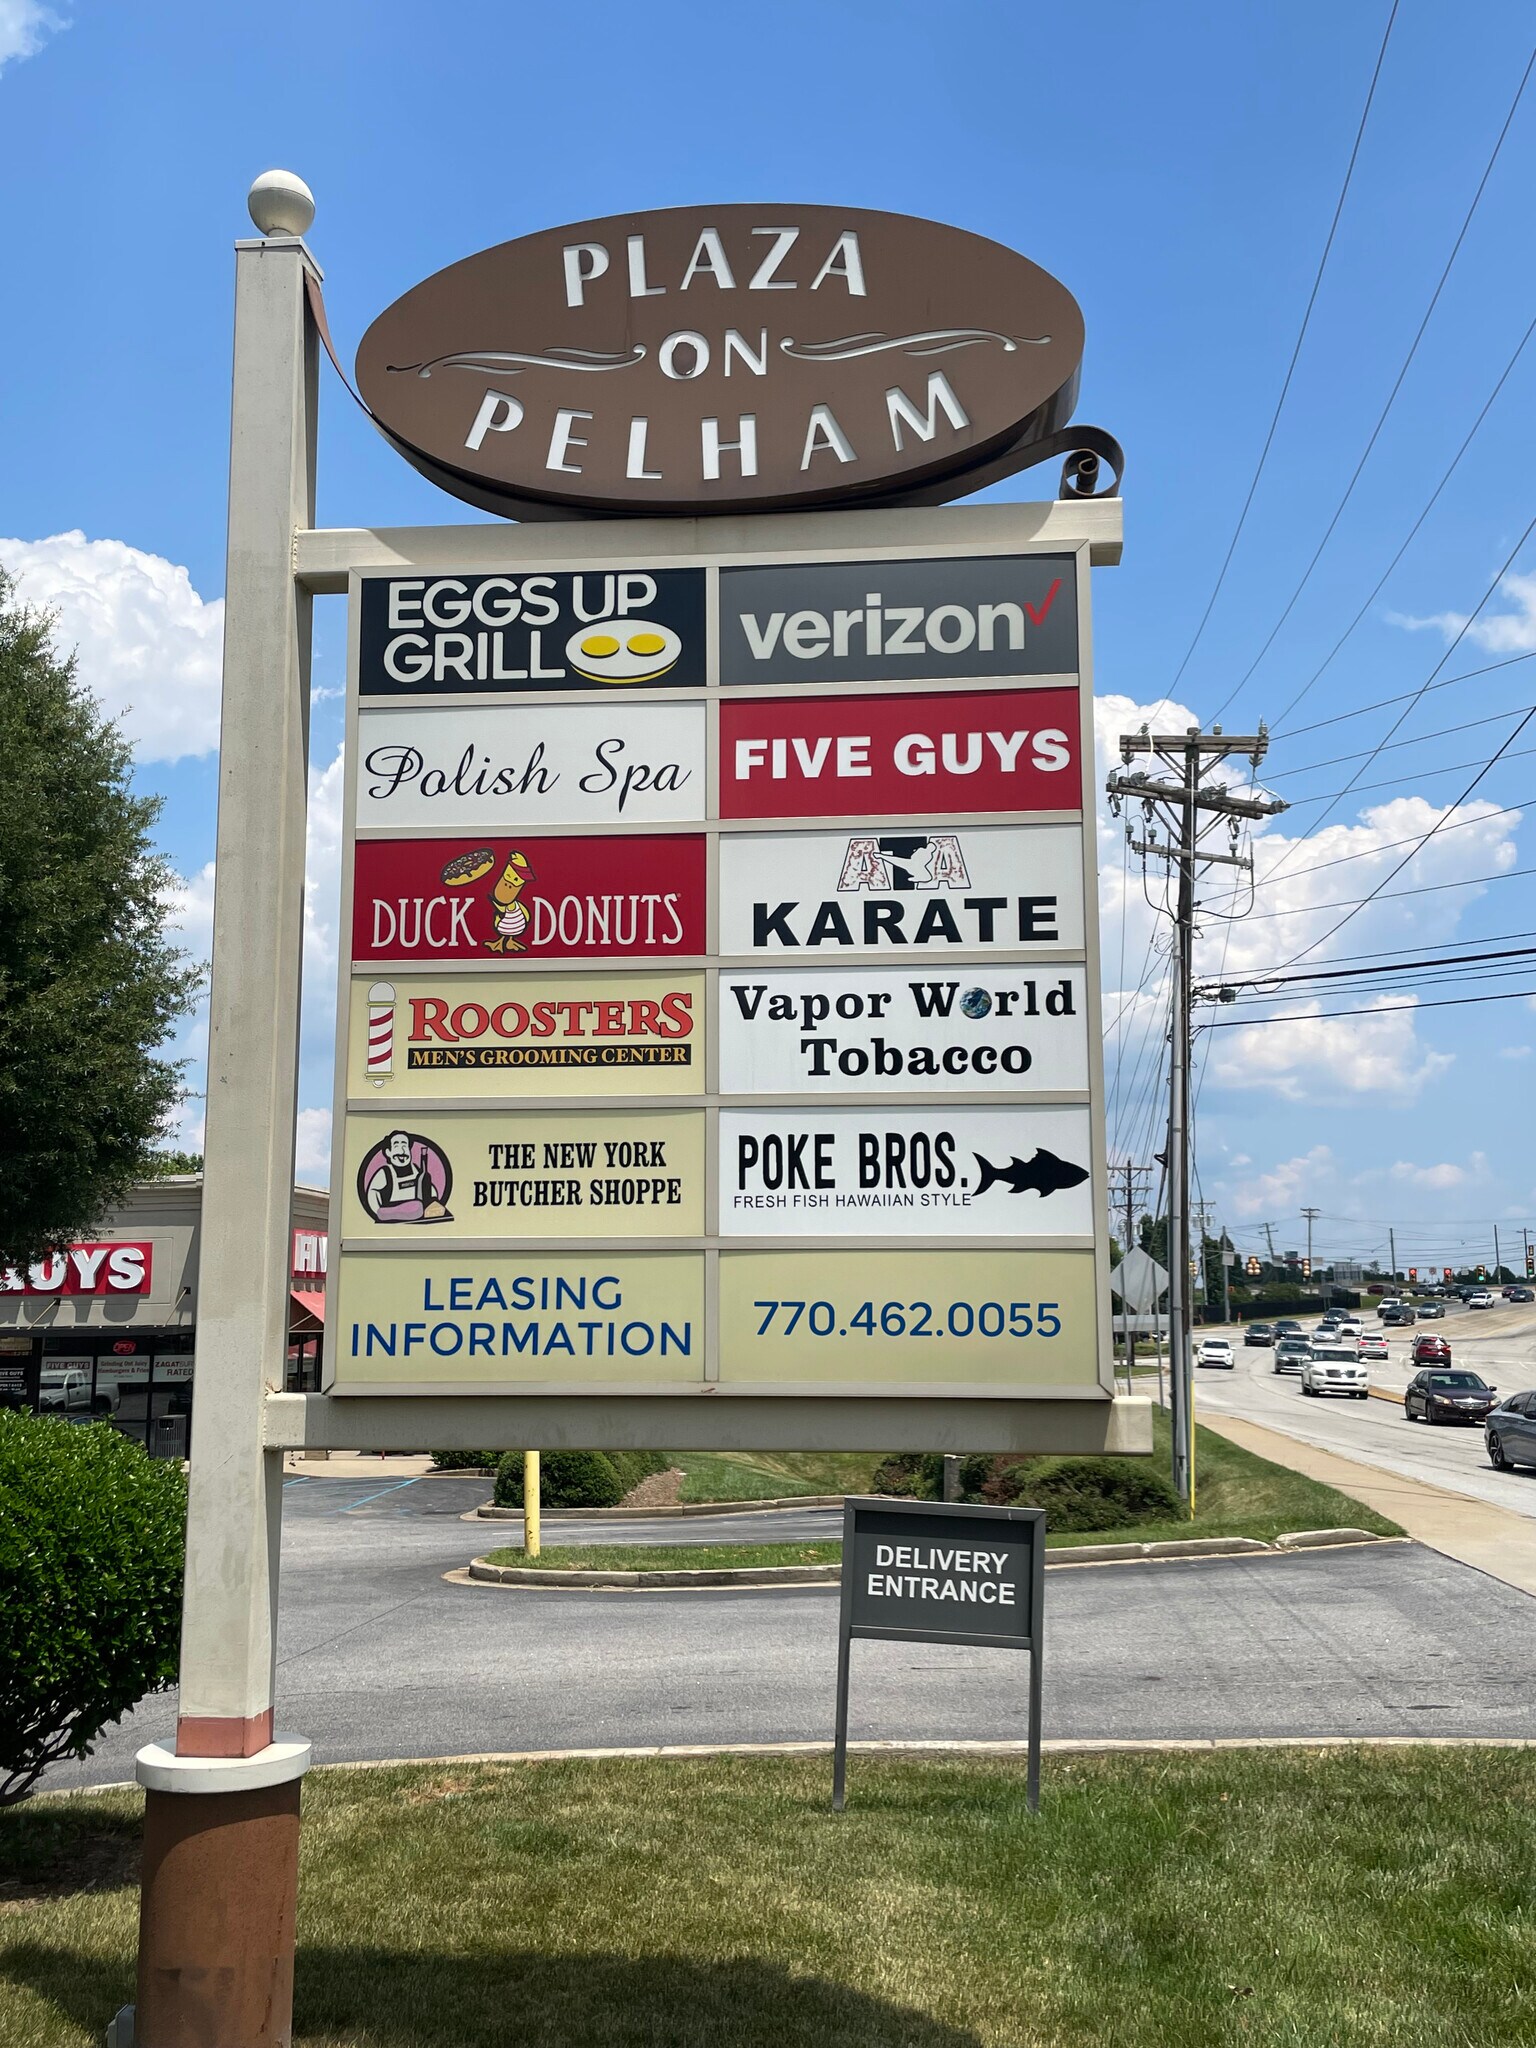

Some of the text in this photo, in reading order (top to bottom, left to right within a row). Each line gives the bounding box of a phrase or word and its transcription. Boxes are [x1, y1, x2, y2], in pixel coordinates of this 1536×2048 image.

[562, 226, 867, 307] PLAZA
[659, 328, 768, 380] ON
[464, 369, 970, 480] PELHAM
[388, 573, 658, 629] EGGS UP
[739, 593, 1025, 660] verizon
[383, 630, 566, 683] GRILL
[365, 738, 692, 813] Polish Spa
[735, 728, 1071, 780] FIVE GUYS
[837, 836, 971, 892] ATA
[371, 893, 684, 948] DUCK DONUTS
[753, 896, 1059, 947] KARATE
[408, 992, 694, 1042] ROOSTERS
[730, 980, 1076, 1031] Vapor World
[412, 1047, 688, 1067] MEN'S GROOMING CENTER
[801, 1038, 1032, 1076] Tobacco
[488, 1141, 667, 1170] THE NEW YORK
[738, 1131, 968, 1190] POKE BROS.
[473, 1178, 682, 1207] BUTCHER SHOPPE
[734, 1193, 971, 1209] FRESH FISH HAWAIIAN STYLE
[294, 1233, 328, 1272] FIV
[424, 1276, 622, 1311] LEASING
[351, 1322, 692, 1356] INFORMATION
[753, 1301, 1062, 1338] 770.462.0055
[876, 1545, 1009, 1575] DELIVERY
[867, 1573, 1016, 1605] ENTRANCE
